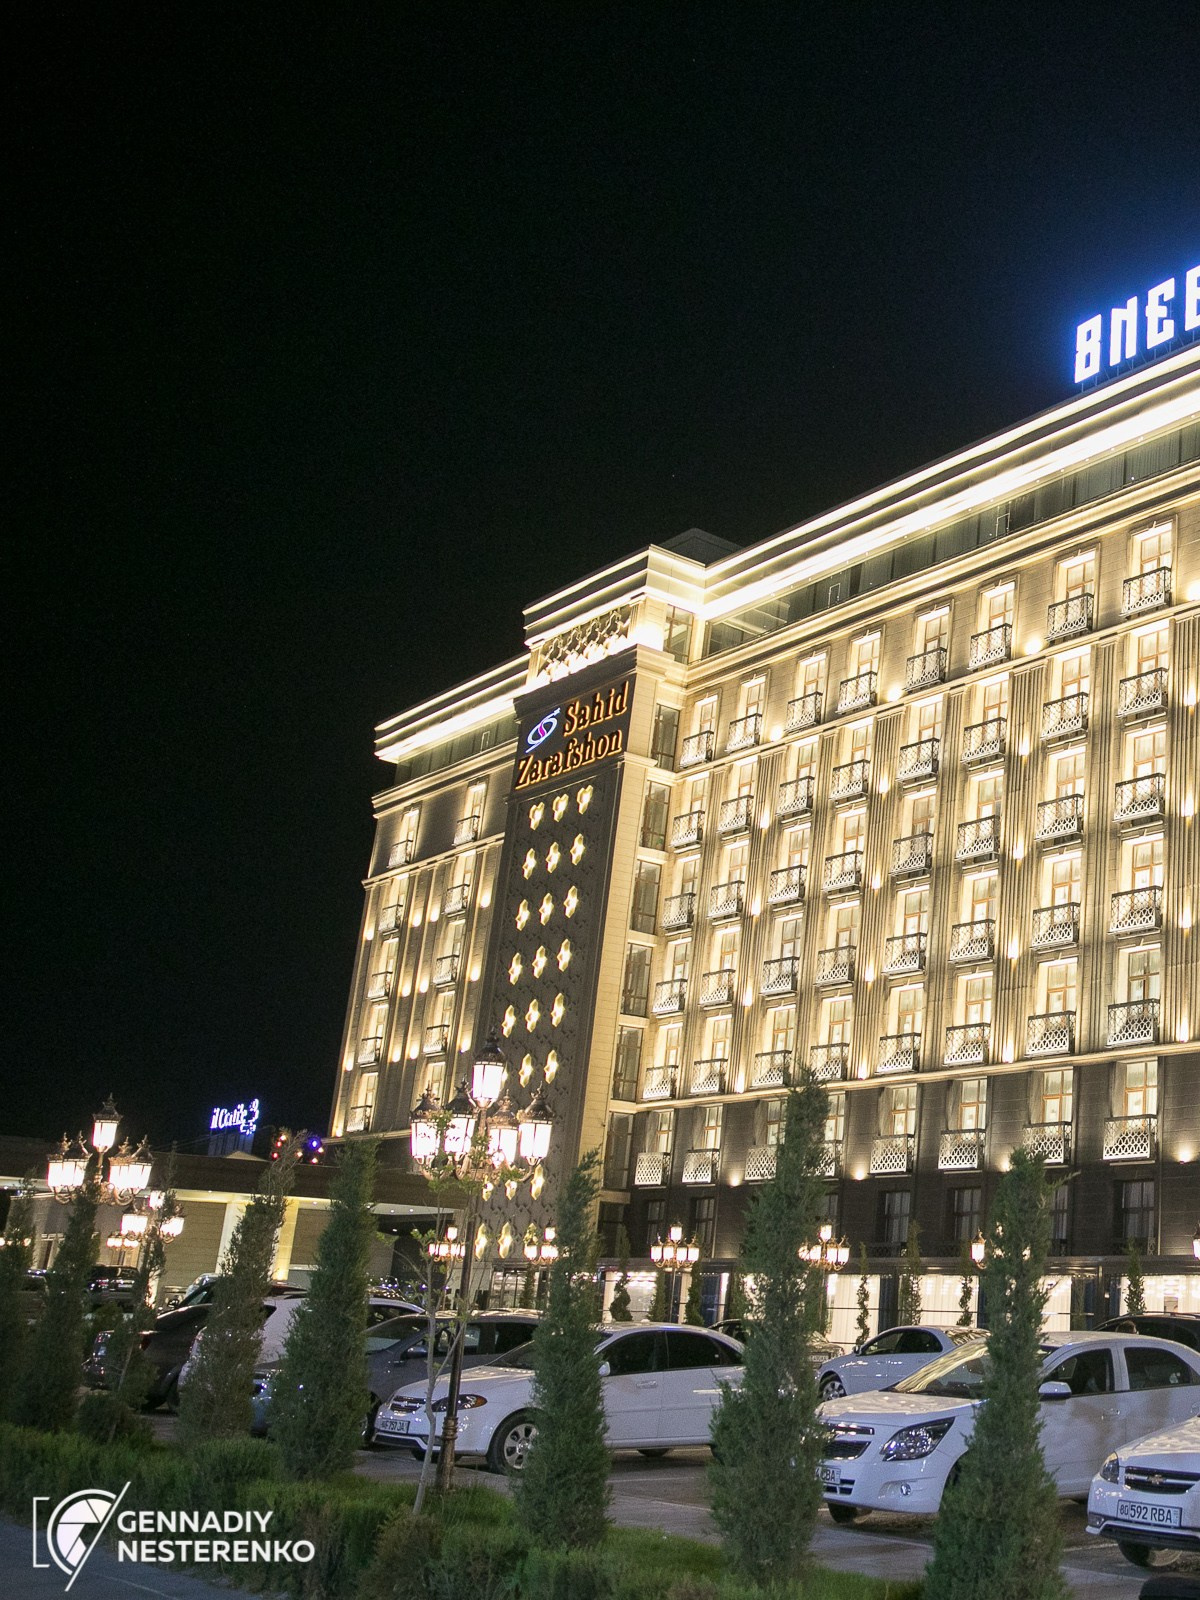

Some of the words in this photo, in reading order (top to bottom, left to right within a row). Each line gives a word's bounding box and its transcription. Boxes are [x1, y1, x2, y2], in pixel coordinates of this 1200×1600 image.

[563, 680, 630, 738] Sahid
[515, 729, 623, 790] Zarafshon
[1130, 1504, 1149, 1520] 592
[1150, 1507, 1173, 1523] RBA
